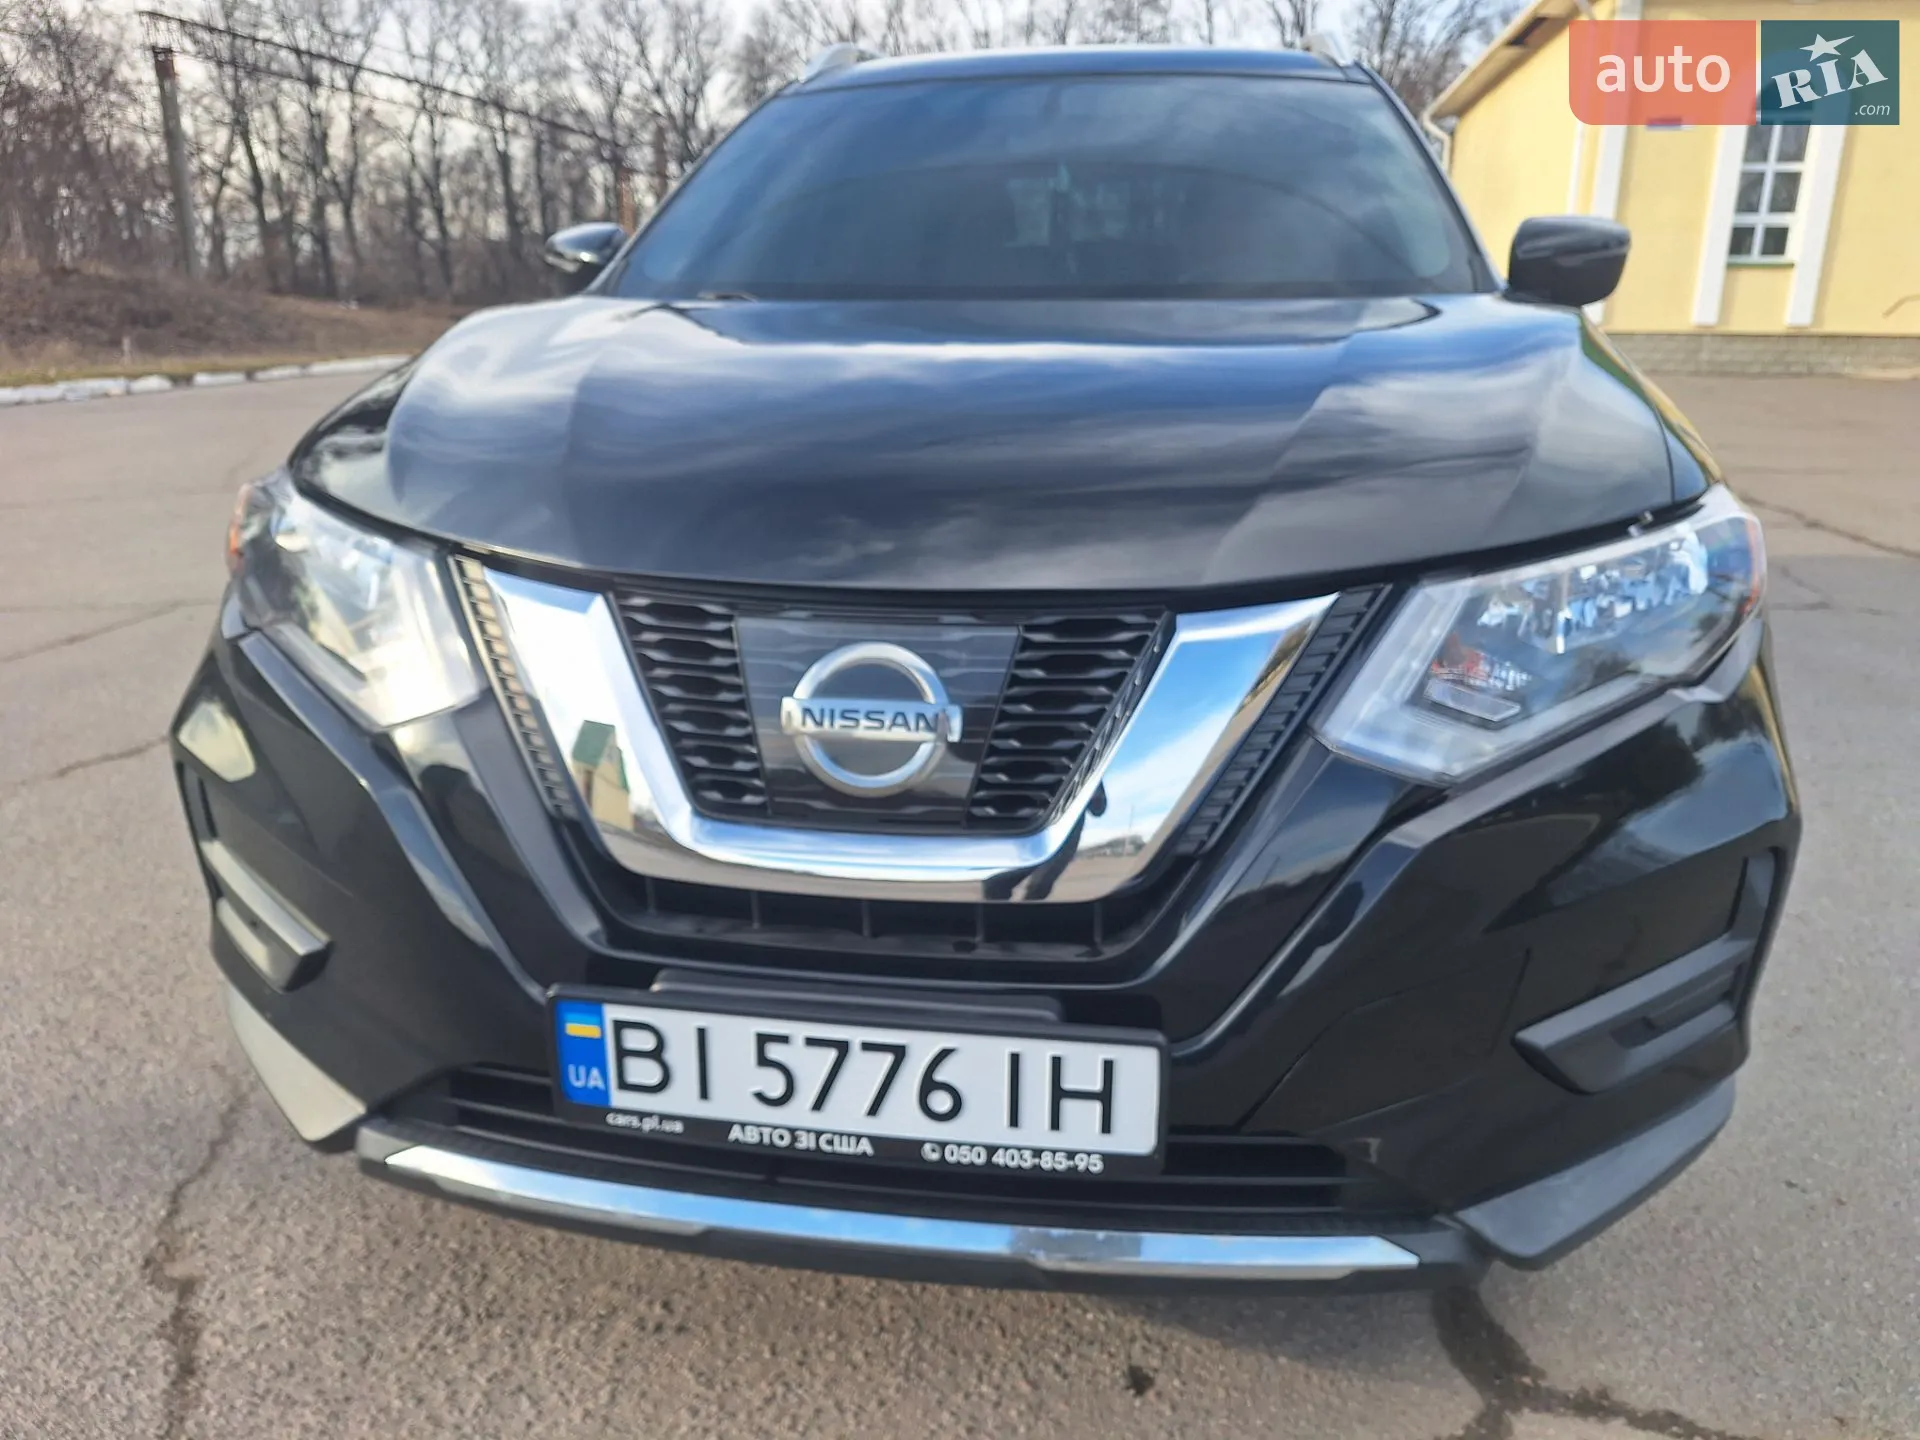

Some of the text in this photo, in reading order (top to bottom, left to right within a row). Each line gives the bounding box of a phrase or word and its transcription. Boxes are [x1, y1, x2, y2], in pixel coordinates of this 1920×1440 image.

[801, 706, 940, 734] NISSAN
[567, 1063, 607, 1091] UA
[612, 1019, 1115, 1136] BI 5776 IH
[727, 1123, 792, 1149] АВТО
[818, 1133, 875, 1157] США
[943, 1143, 1105, 1175] 050 403-85-95
